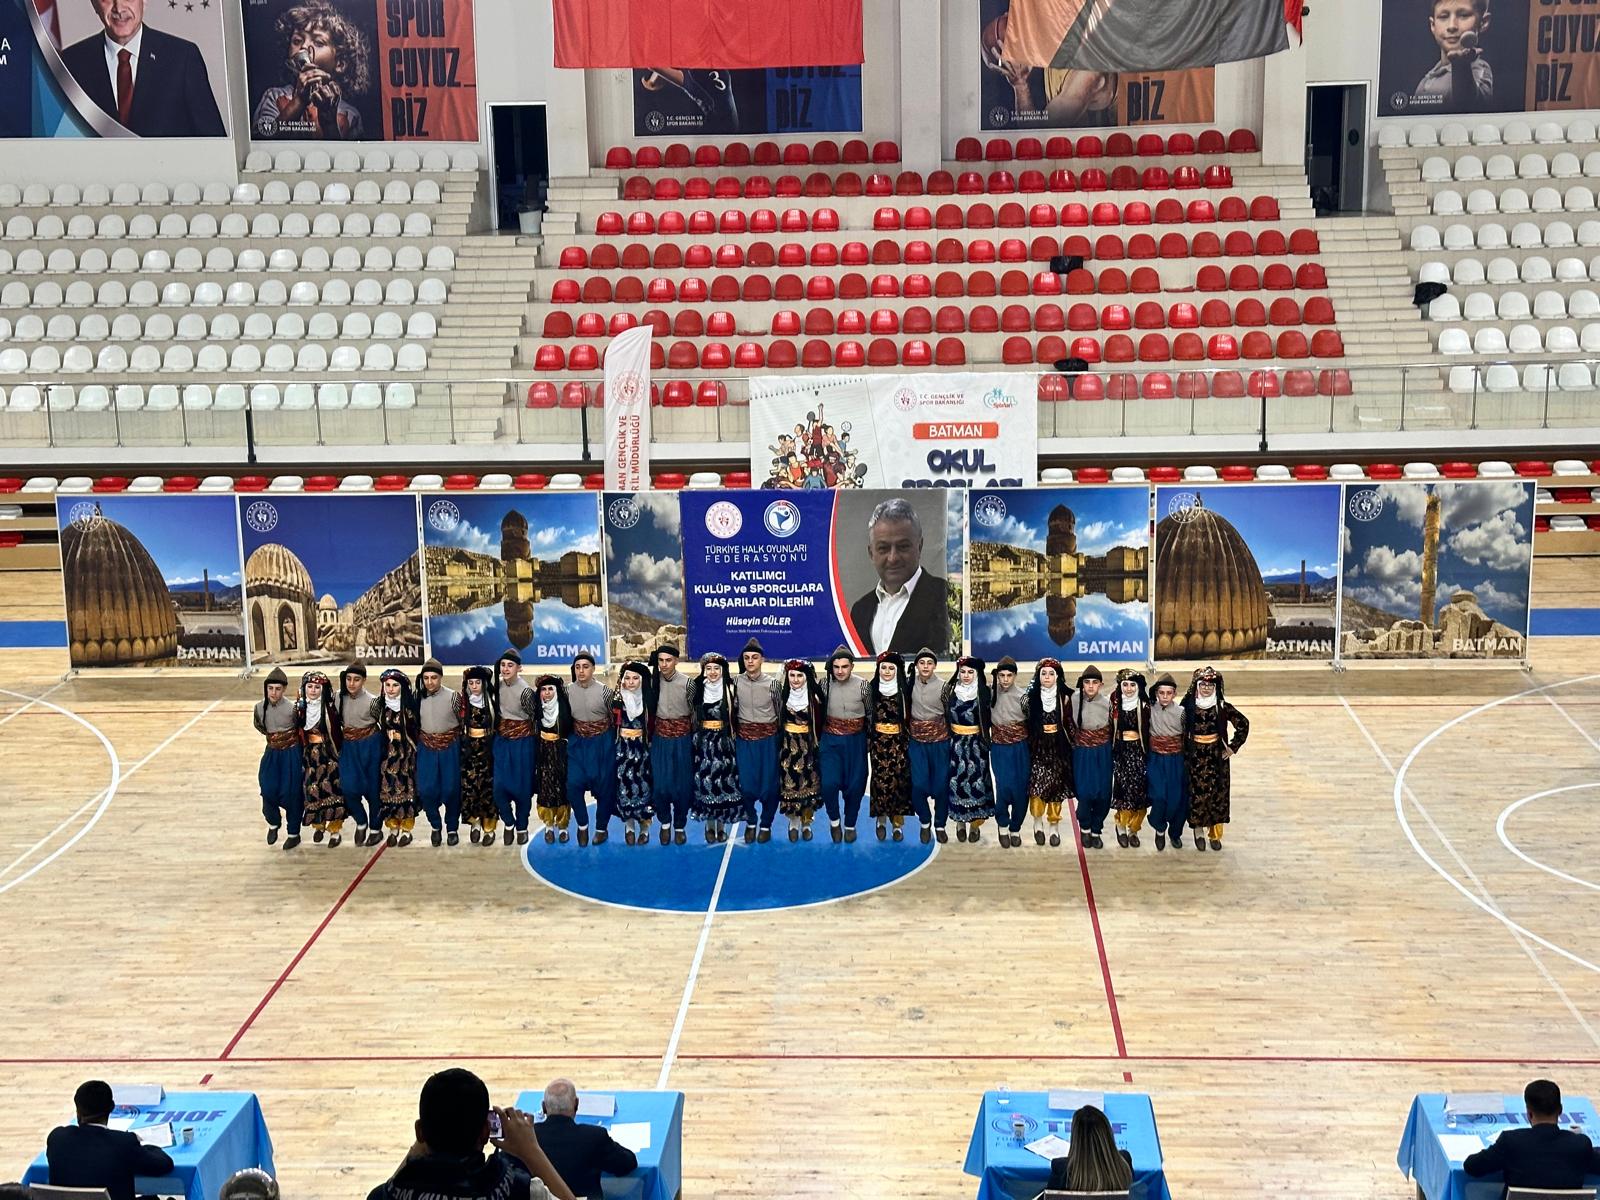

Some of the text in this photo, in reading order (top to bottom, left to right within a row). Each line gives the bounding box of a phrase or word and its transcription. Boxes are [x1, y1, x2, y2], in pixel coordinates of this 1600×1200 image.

[386, 0, 445, 38] SPOR
[1534, 59, 1573, 102] BİZ
[1127, 76, 1166, 121] BİZ
[776, 84, 813, 129] BİZ
[391, 92, 429, 137] BİZ
[618, 415, 627, 429] VE
[928, 423, 983, 438] BATMAN
[617, 430, 628, 469] GENÇLİK
[629, 414, 640, 474] MÜDÜRLÜĞÜ
[927, 448, 996, 474] OKUL
[705, 544, 807, 554] TÜRKİYE HALK OYUNLARI
[705, 553, 807, 563] FEDERASYONU
[730, 571, 786, 581] KATILIMCI
[694, 583, 731, 594] KULÜP
[749, 583, 824, 593] SPORCULARA
[704, 595, 814, 609] BAŞARILAR DİLERİM
[726, 614, 791, 627] Hüseyin GÜLER
[537, 644, 601, 658] BATMAN
[1077, 640, 1143, 654] BATMAN
[1266, 638, 1332, 652] BATMAN
[1451, 637, 1522, 651] BATMAN
[177, 645, 241, 660] BATMAN
[355, 645, 419, 658] BATMAN
[144, 1110, 227, 1123] THOF
[1043, 1120, 1128, 1134] TF
